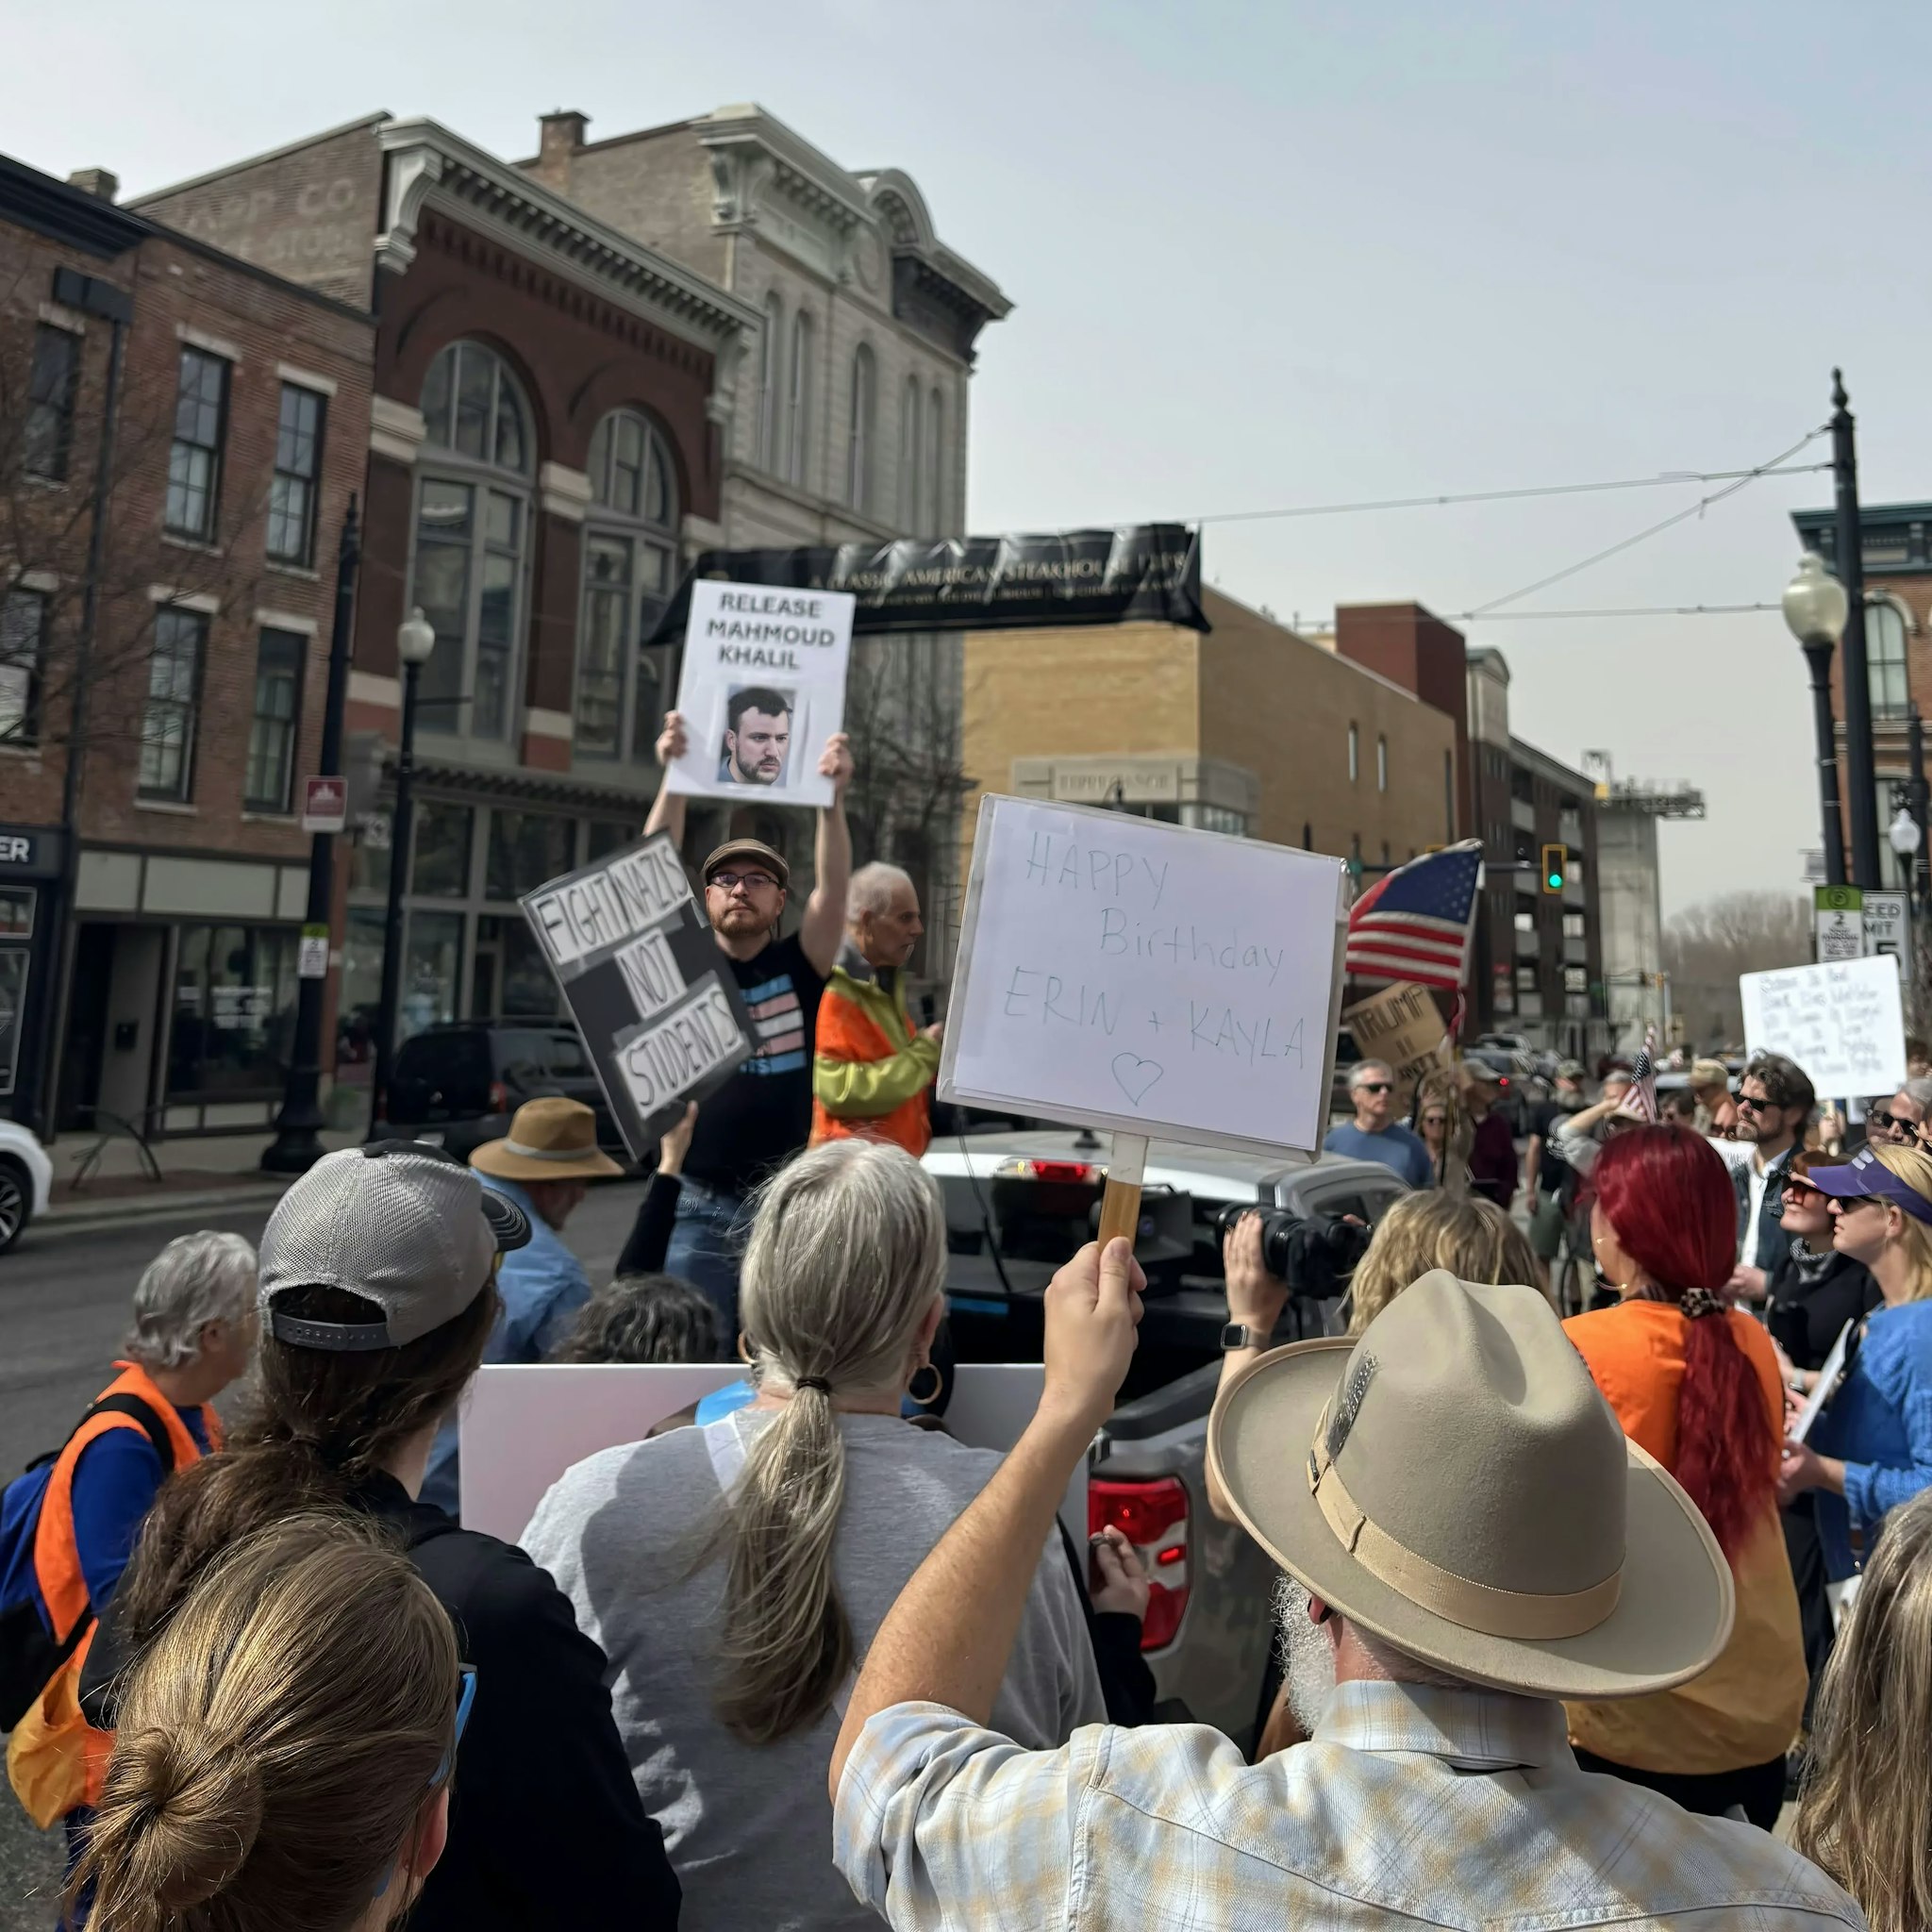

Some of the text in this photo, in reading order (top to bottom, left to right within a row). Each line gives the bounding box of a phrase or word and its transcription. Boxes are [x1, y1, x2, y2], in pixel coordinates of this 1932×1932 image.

[719, 591, 823, 619] RELEASE
[903, 564, 998, 585] AMERICAN
[1003, 556, 1130, 581] STEAKHOUE
[707, 619, 836, 647] MAHMOUD
[719, 644, 800, 670] KHALIL
[0, 835, 30, 862] ER
[1026, 831, 1169, 909] HAPPY
[537, 845, 690, 958] FIGHT NAZIS
[619, 935, 679, 1013] NOT
[1100, 908, 1284, 987] Birthday
[1004, 966, 1123, 1036] ERIN
[1190, 1000, 1305, 1070] KAYLA
[1349, 983, 1424, 1043] TRUMP
[626, 991, 741, 1108] STUDENTS
